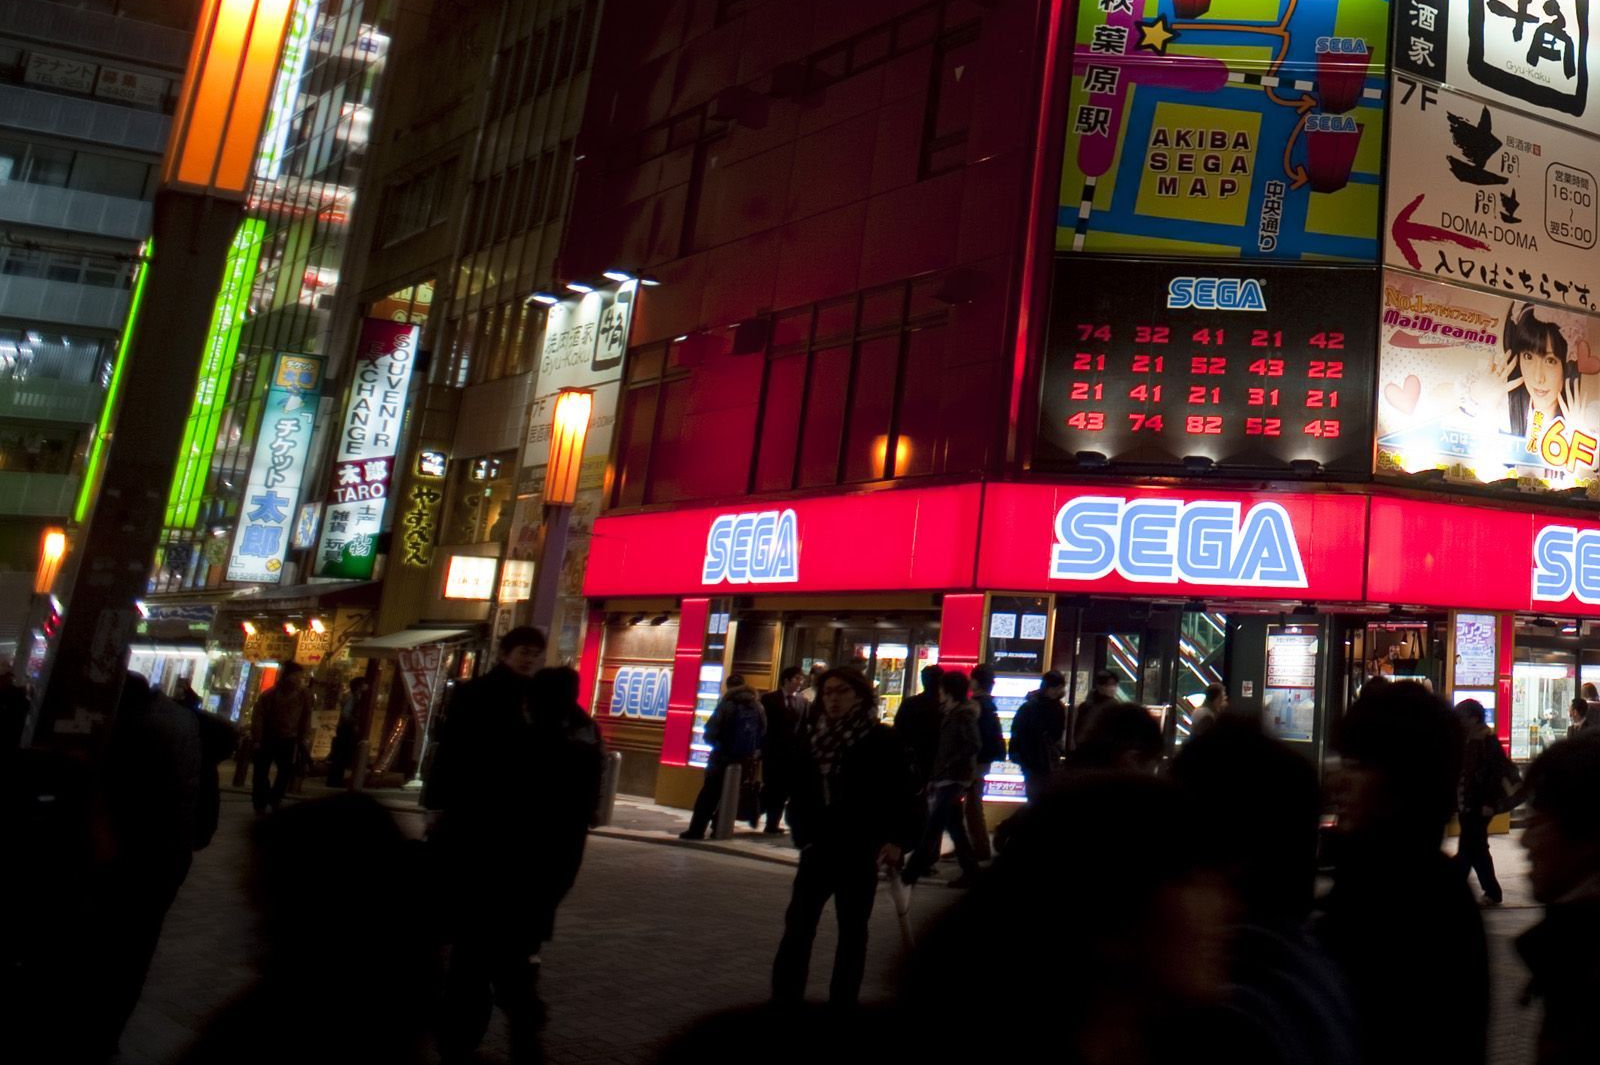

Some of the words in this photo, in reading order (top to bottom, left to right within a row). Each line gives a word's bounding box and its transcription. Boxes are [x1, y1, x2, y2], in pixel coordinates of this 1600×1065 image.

[1315, 36, 1368, 54] SEGA
[1505, 59, 1551, 84] Gyu-Kaku
[1397, 77, 1439, 112] 7F
[1305, 115, 1358, 133] SEGA
[1151, 128, 1251, 151] AKIBA
[1149, 152, 1250, 175] SEGA
[1157, 176, 1238, 198] MAP
[1554, 169, 1590, 191] 営業時間
[1552, 184, 1591, 208] 16:00
[1258, 180, 1286, 253] 中央通り
[1441, 212, 1539, 252] DOMA-DOMA
[1549, 220, 1592, 244] 翌5:00
[1167, 277, 1267, 311] SEGA
[1077, 325, 1111, 341] 74
[1135, 326, 1169, 343] 32
[1192, 329, 1224, 344] 41
[1251, 330, 1282, 347] 21
[1309, 333, 1344, 349] 42
[1383, 308, 1498, 345] MaiDreamin
[1073, 353, 1105, 370] 21
[1132, 355, 1164, 373] 21
[1191, 357, 1226, 374] 52
[1249, 359, 1284, 376] 43
[1307, 361, 1343, 378] 22
[345, 342, 385, 455] EXCHANGE
[373, 333, 411, 448] SOUVENIR
[1071, 383, 1103, 400] 21
[1129, 385, 1161, 402] 41
[1188, 386, 1220, 403] 21
[1248, 388, 1279, 406] 31
[1306, 390, 1337, 408] 21
[1068, 412, 1104, 430] 43
[1129, 414, 1163, 432] 74
[1186, 416, 1222, 433] 82
[1246, 418, 1281, 435] 52
[1304, 420, 1339, 437] 43
[1541, 419, 1597, 473] 6F
[338, 460, 388, 485] 太郎
[334, 483, 385, 503] TARO
[701, 507, 798, 586] SEGA
[1050, 495, 1309, 589] SEGA
[610, 665, 672, 722] SEGA
